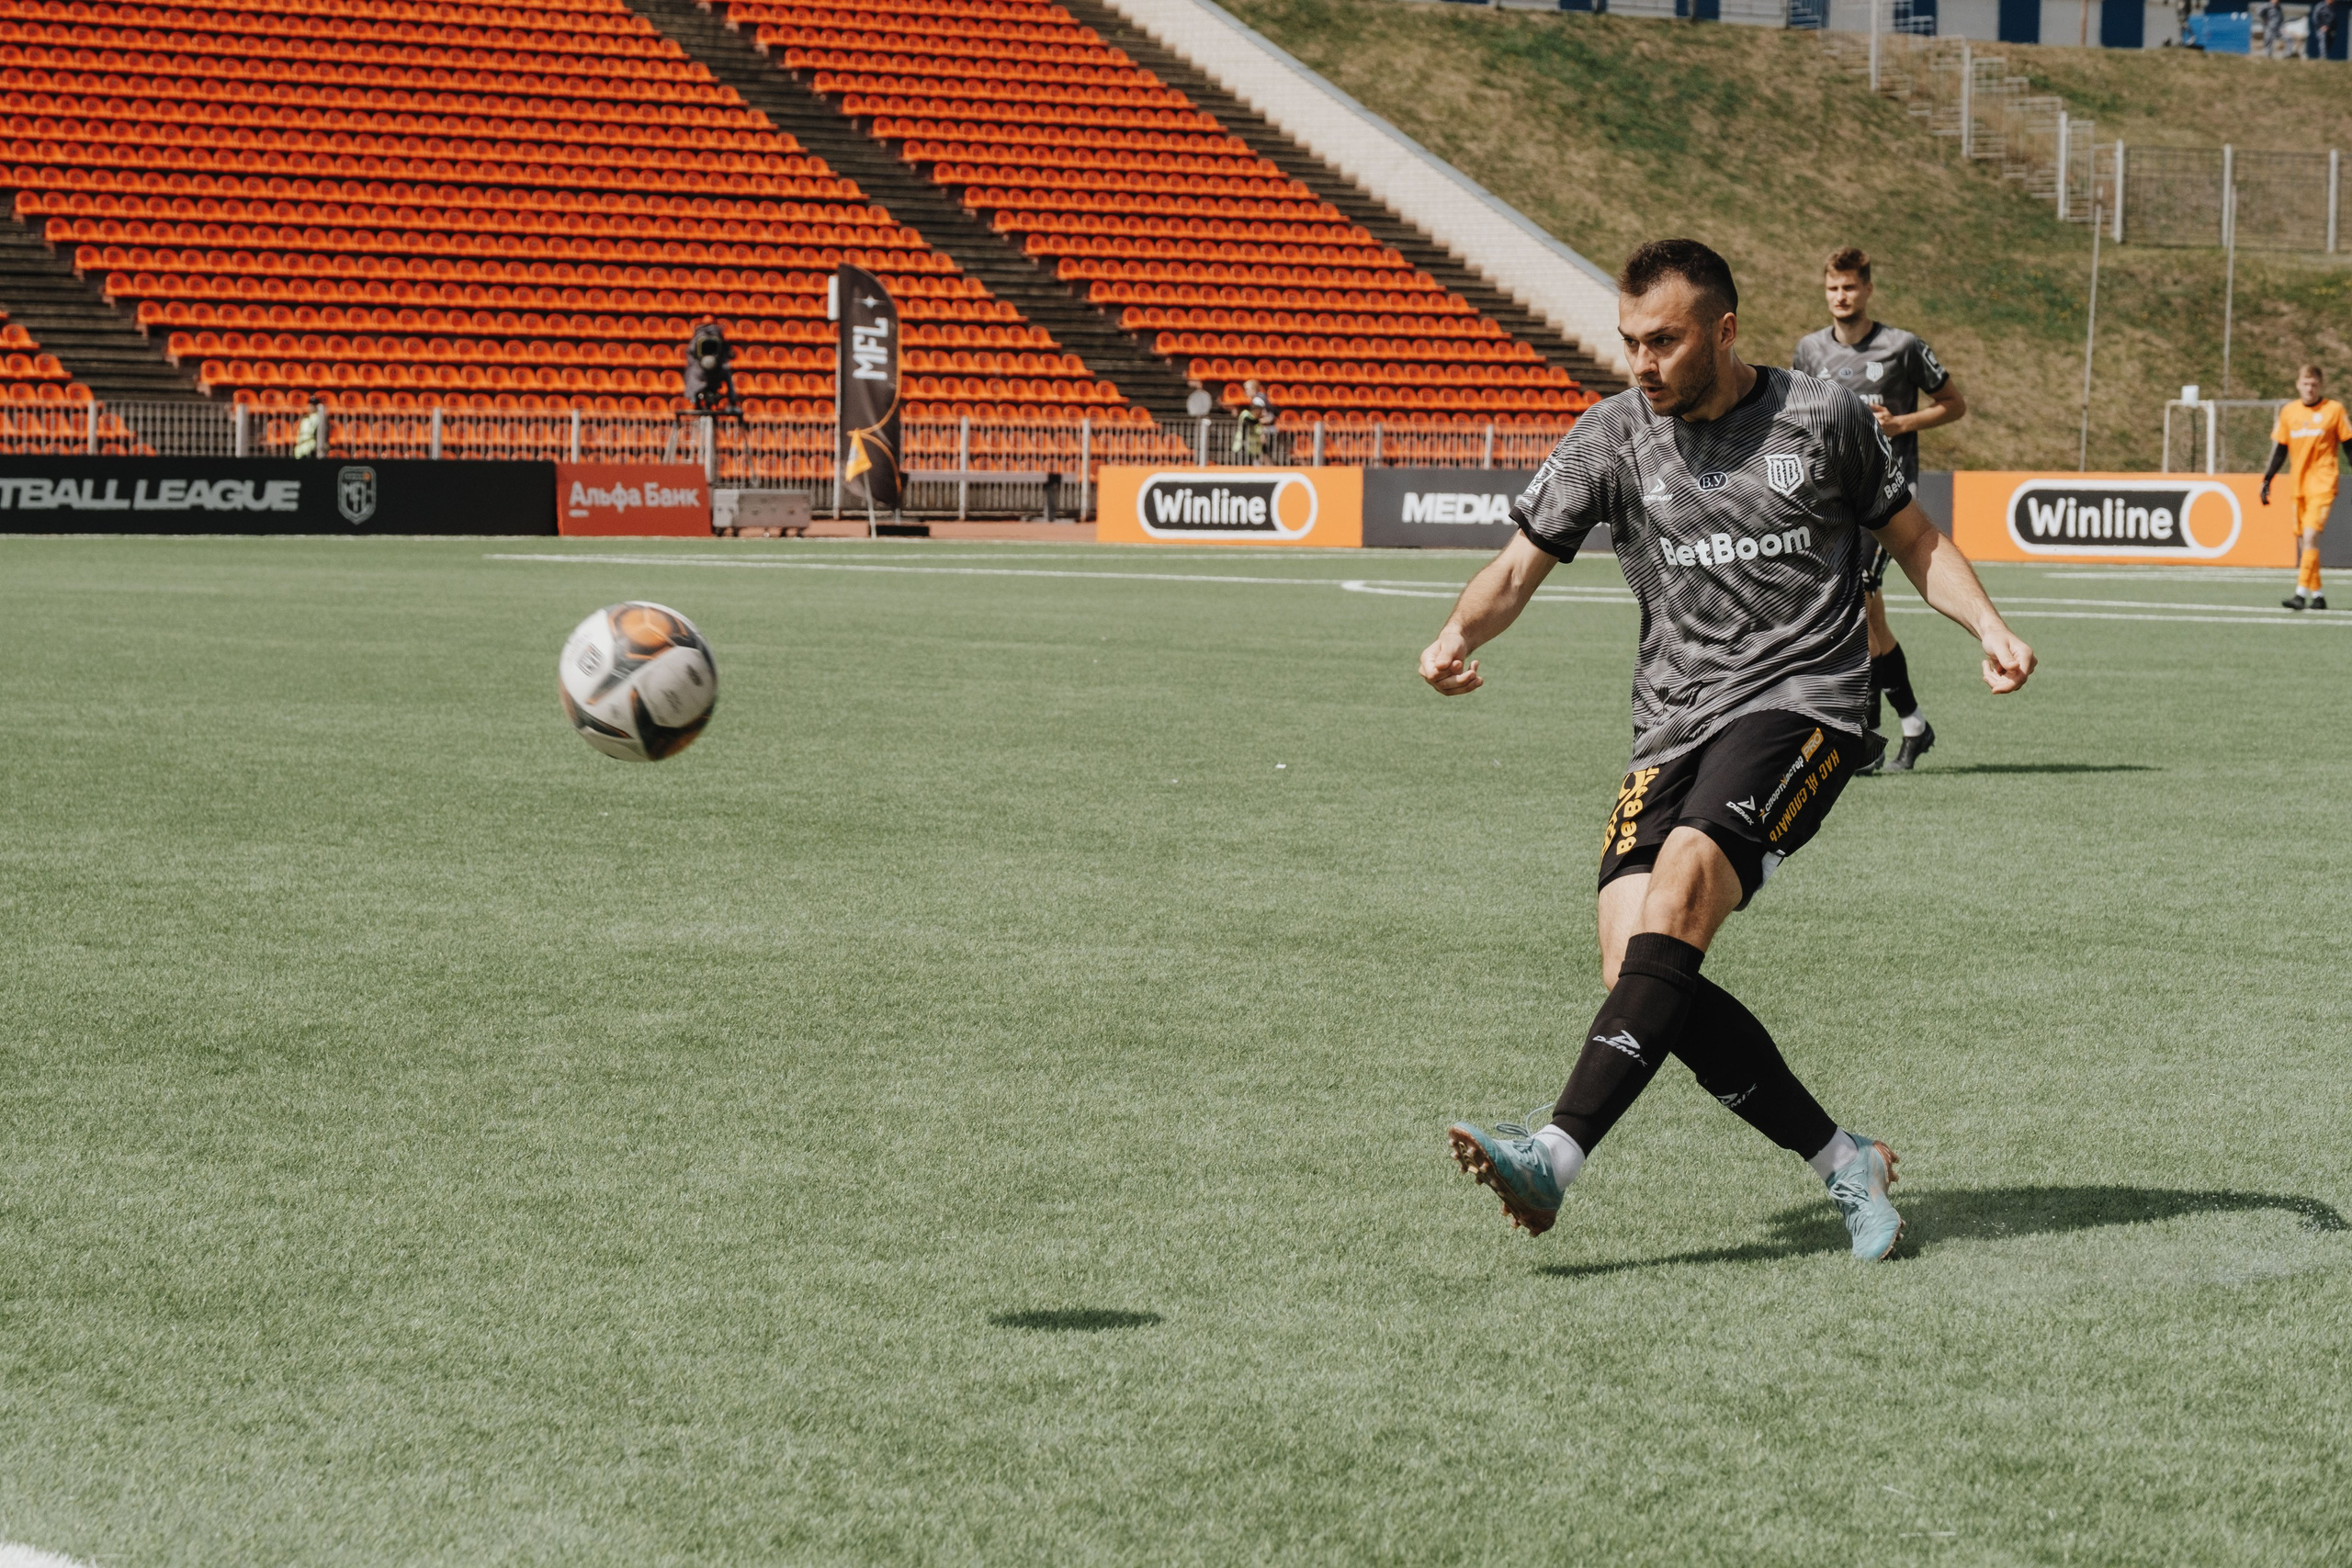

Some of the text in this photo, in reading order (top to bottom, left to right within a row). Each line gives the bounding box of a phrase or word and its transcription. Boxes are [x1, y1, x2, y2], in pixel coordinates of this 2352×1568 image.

[852, 316, 889, 381] MFL
[0, 478, 301, 512] TBALL LEAGUE
[569, 479, 701, 513] Альфа Банк
[1152, 488, 1267, 525] Winline
[1401, 491, 1514, 525] MEDIA
[2027, 497, 2174, 540] Winline
[1659, 525, 1812, 567] BetBoom
[1803, 732, 1822, 757] PRO
[1818, 749, 1840, 780] НАС
[1726, 800, 1755, 826] DEMIX
[1592, 1034, 1648, 1067] DEMIX
